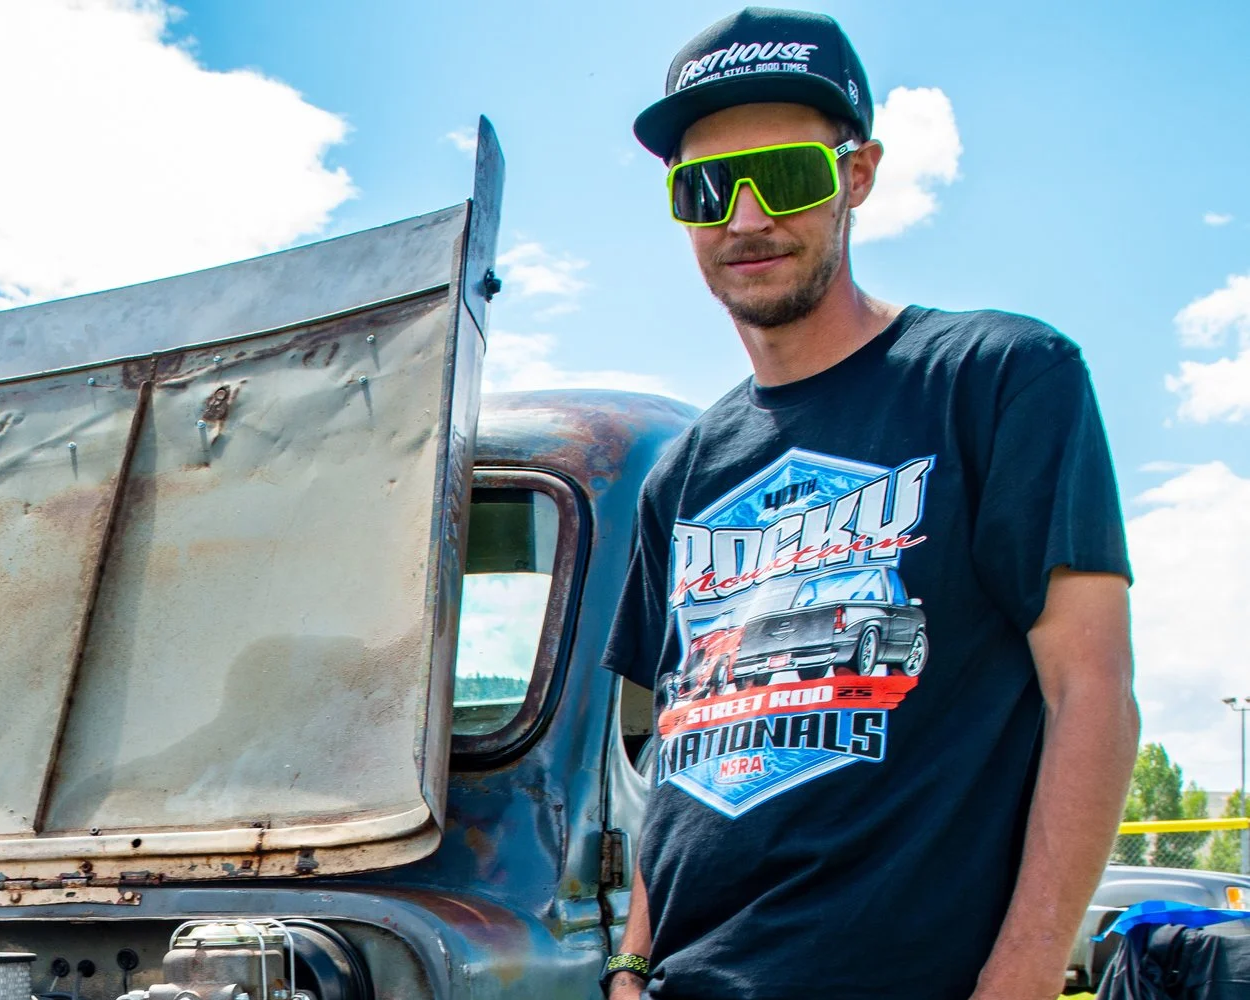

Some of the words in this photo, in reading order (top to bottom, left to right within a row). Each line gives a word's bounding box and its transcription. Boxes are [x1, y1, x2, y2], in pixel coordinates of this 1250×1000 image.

[675, 42, 818, 91] FASTHOUSE
[756, 62, 779, 73] GOOD
[781, 62, 808, 73] TIMES
[672, 458, 934, 606] ROCKY
[670, 534, 927, 601] Mountain
[687, 693, 767, 724] STREET
[769, 686, 833, 708] ROD
[659, 711, 886, 783] NATIONALS
[720, 756, 762, 777] NSRA
